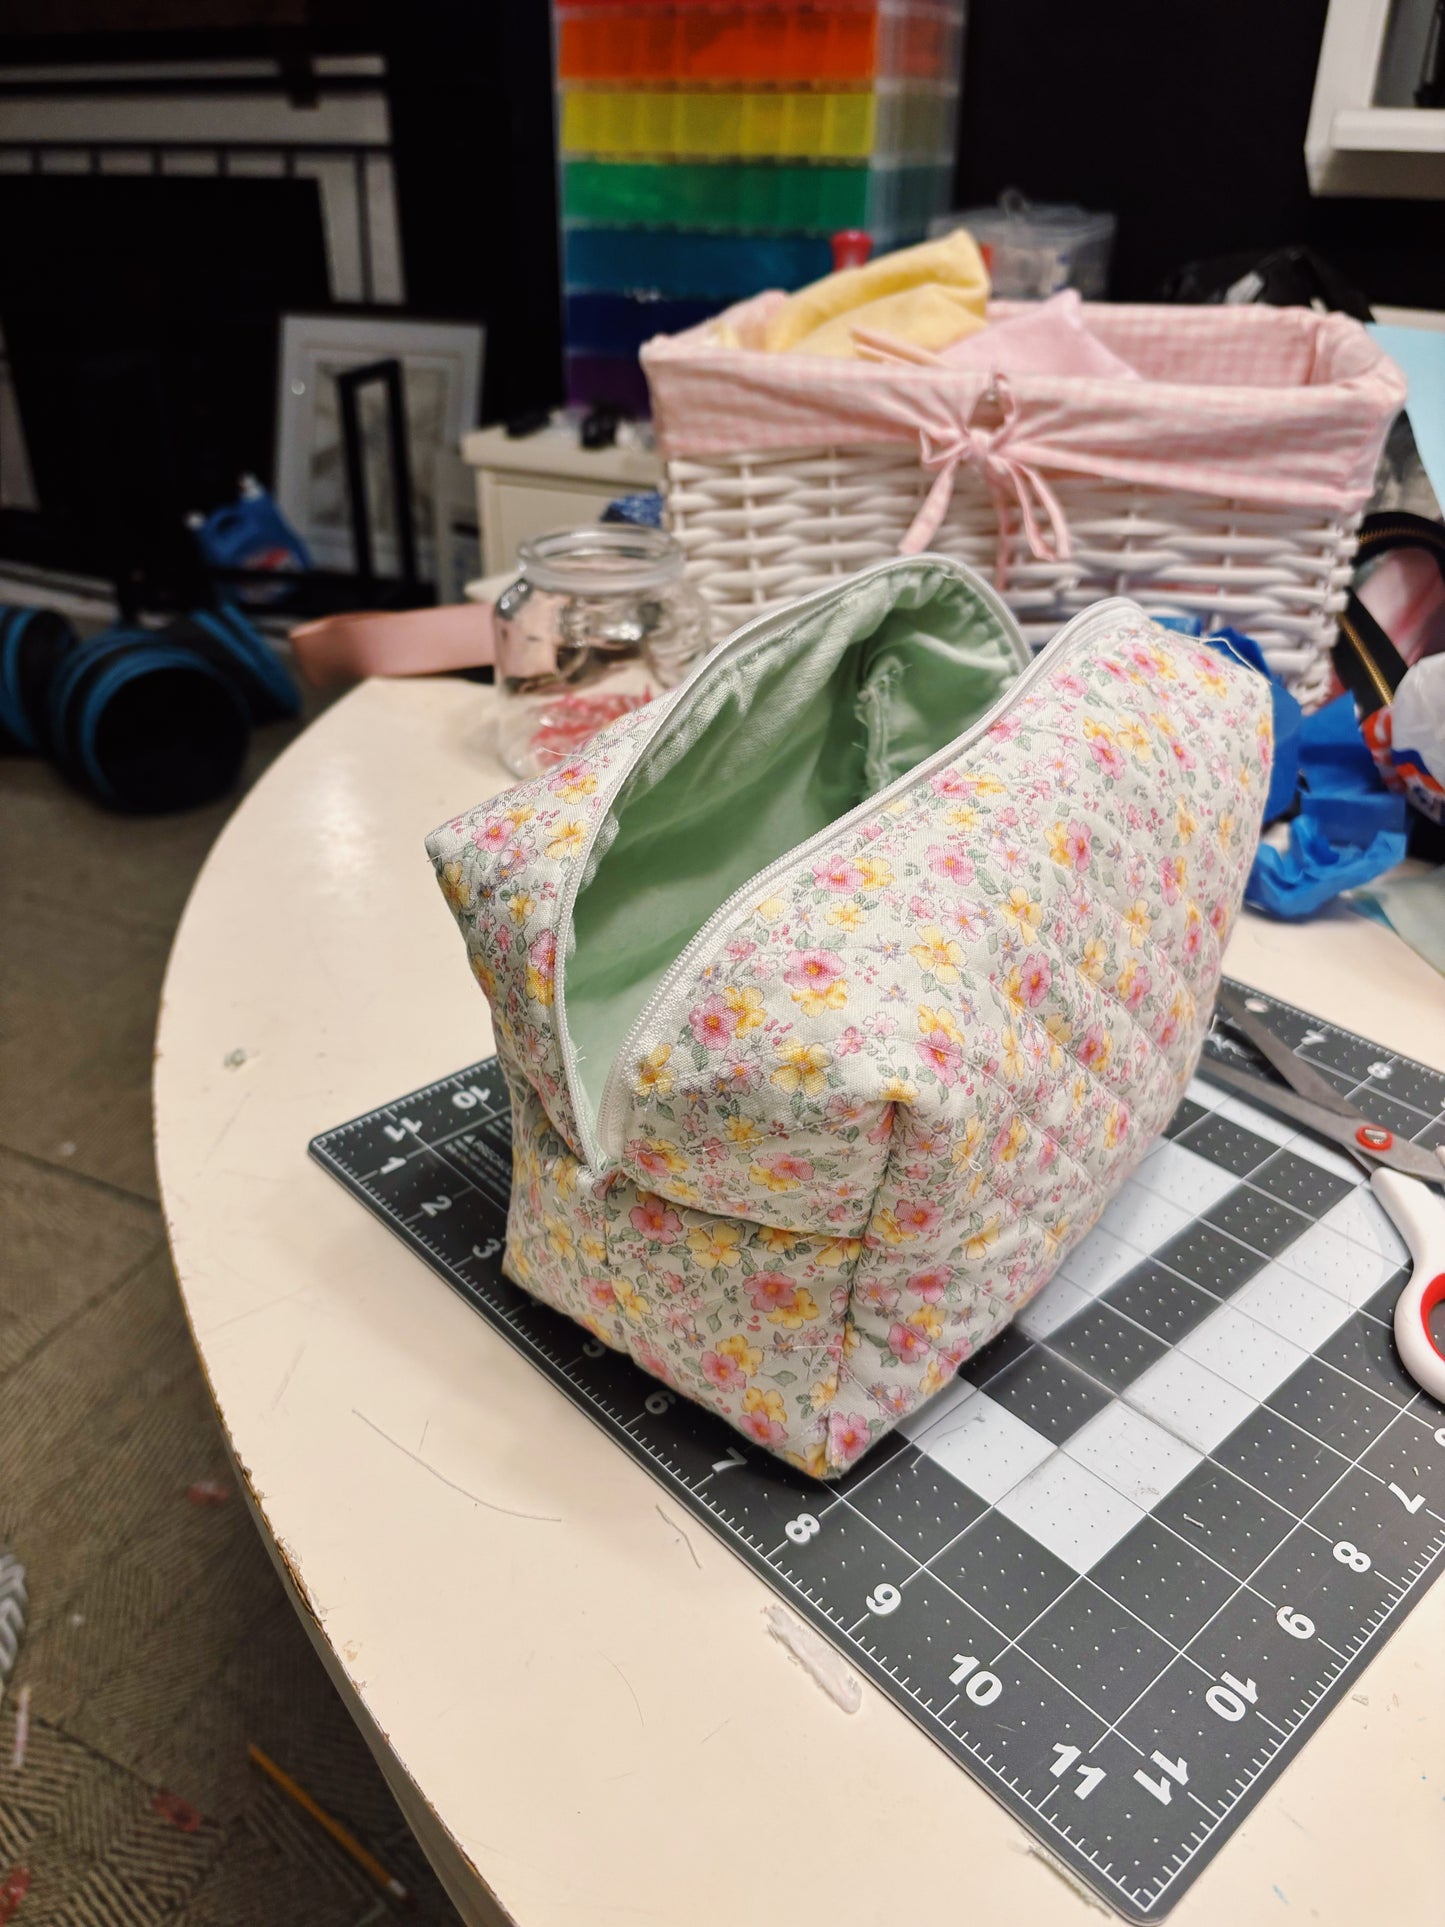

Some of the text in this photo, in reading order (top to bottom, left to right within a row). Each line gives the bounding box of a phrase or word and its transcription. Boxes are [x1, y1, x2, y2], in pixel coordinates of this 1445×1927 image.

[1367, 1061, 1393, 1080] 8
[452, 1085, 491, 1109] 10
[383, 1117, 423, 1143] 11
[380, 1156, 407, 1175] 1
[421, 1195, 452, 1217] 2
[472, 1238, 502, 1259] 3
[644, 1390, 676, 1415] 6
[712, 1447, 748, 1472] 7
[1388, 1482, 1426, 1514] 7
[785, 1513, 820, 1544] 8
[1332, 1541, 1372, 1573] 8
[866, 1583, 902, 1615] 9
[1276, 1605, 1316, 1640] 9
[948, 1653, 1003, 1707] 10
[1205, 1671, 1259, 1722] 10
[1049, 1742, 1107, 1800] 11
[1133, 1750, 1189, 1806] 11
